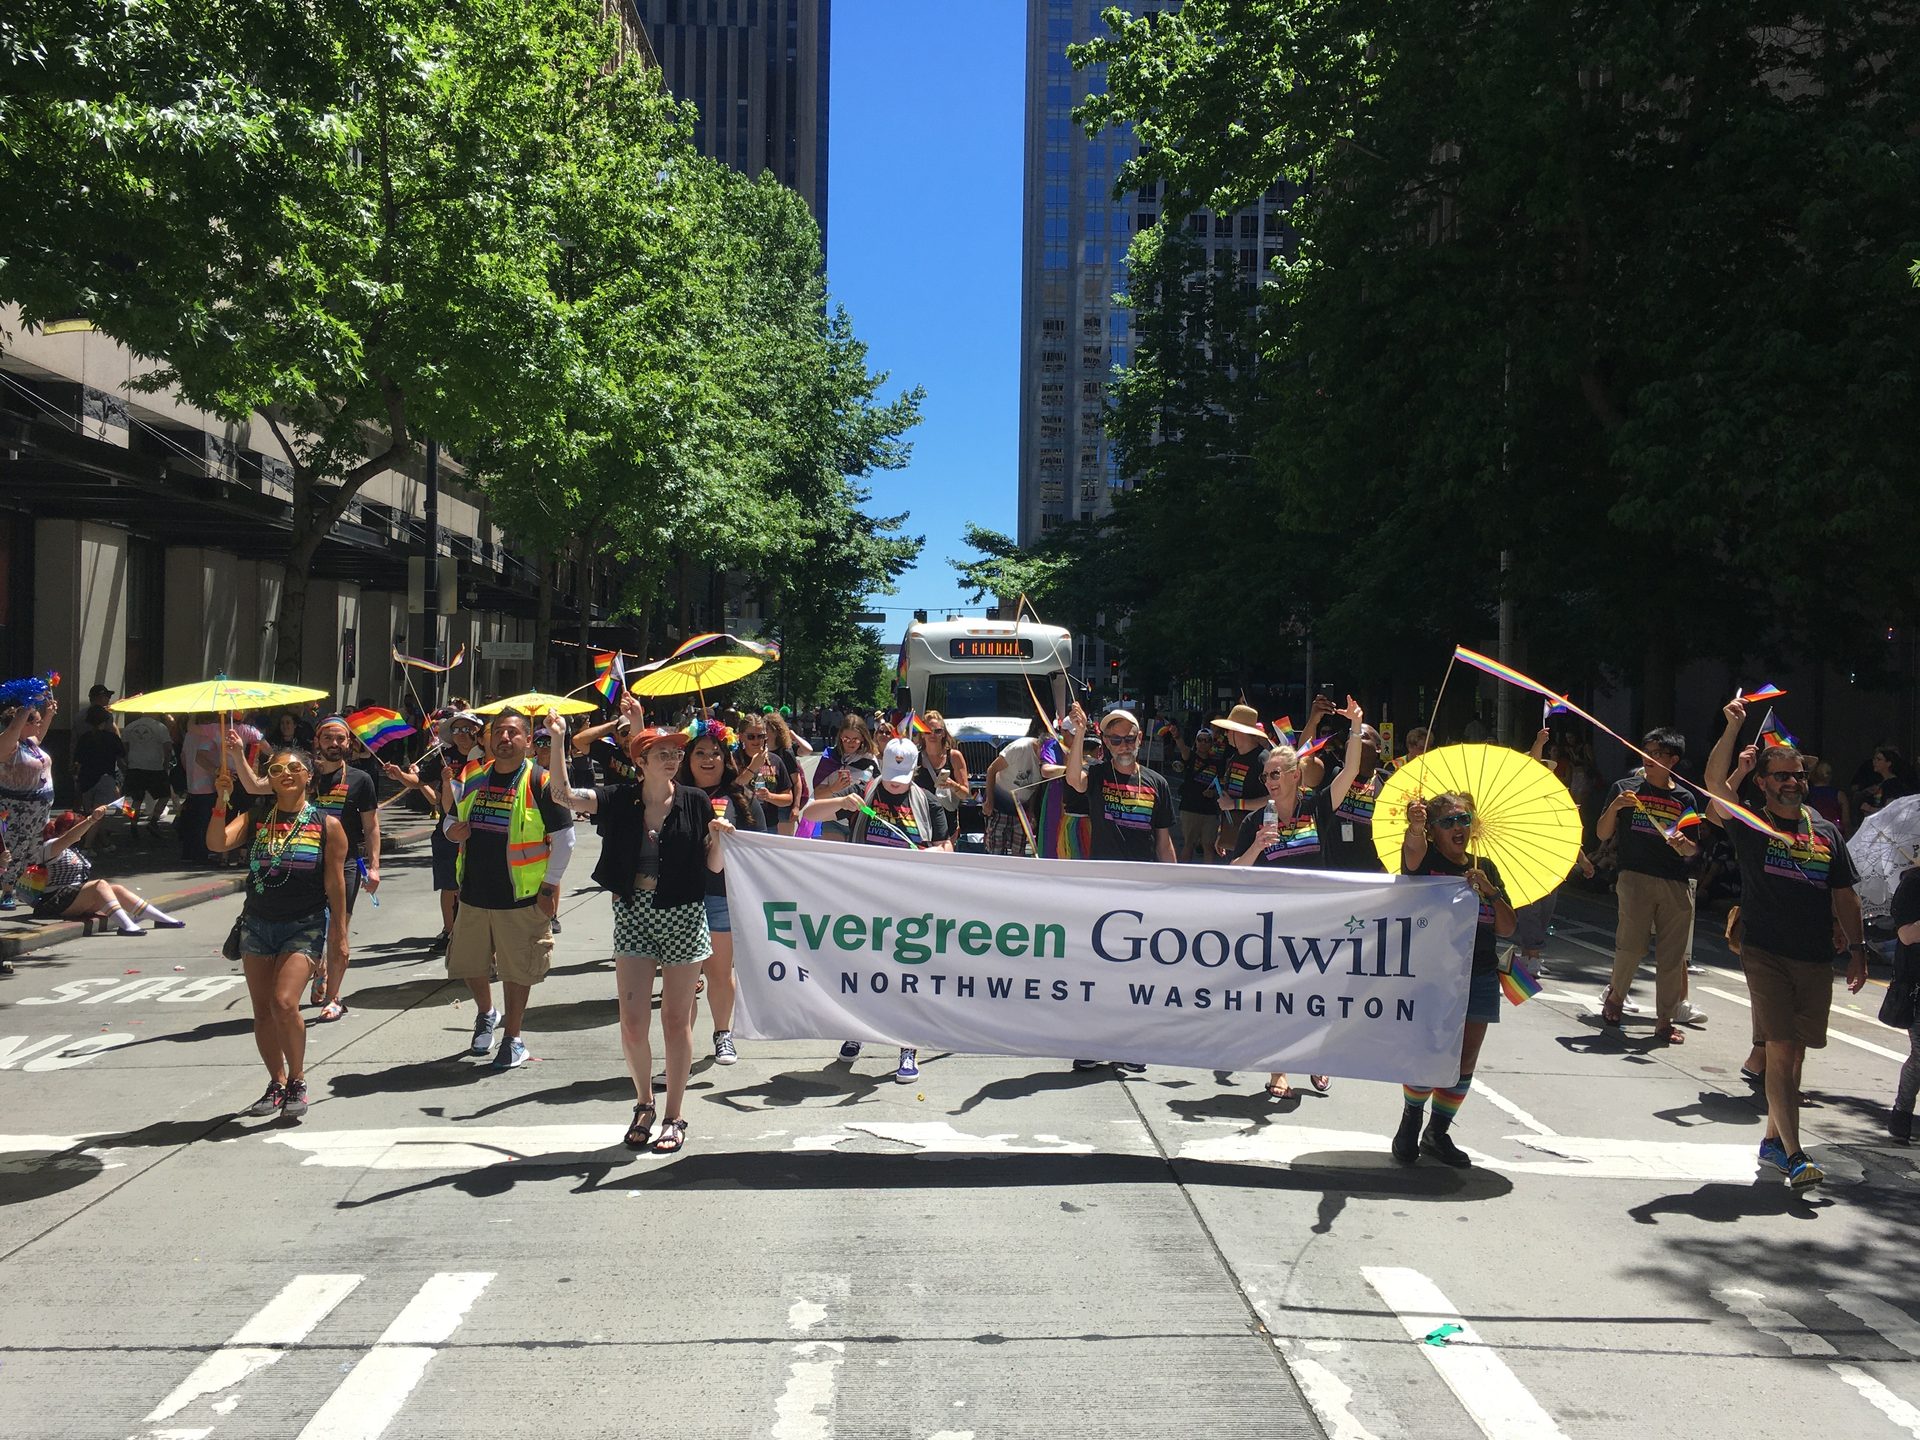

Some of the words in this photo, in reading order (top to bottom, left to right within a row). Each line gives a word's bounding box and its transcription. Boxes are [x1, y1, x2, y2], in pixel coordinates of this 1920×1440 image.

[867, 826, 889, 837] LIVES
[1764, 855, 1793, 869] LIVES
[762, 901, 1066, 965] Evergreen
[767, 961, 809, 982] OF
[841, 971, 1095, 1002] NORTHWEST
[1128, 983, 1415, 1022] WASHINGTON
